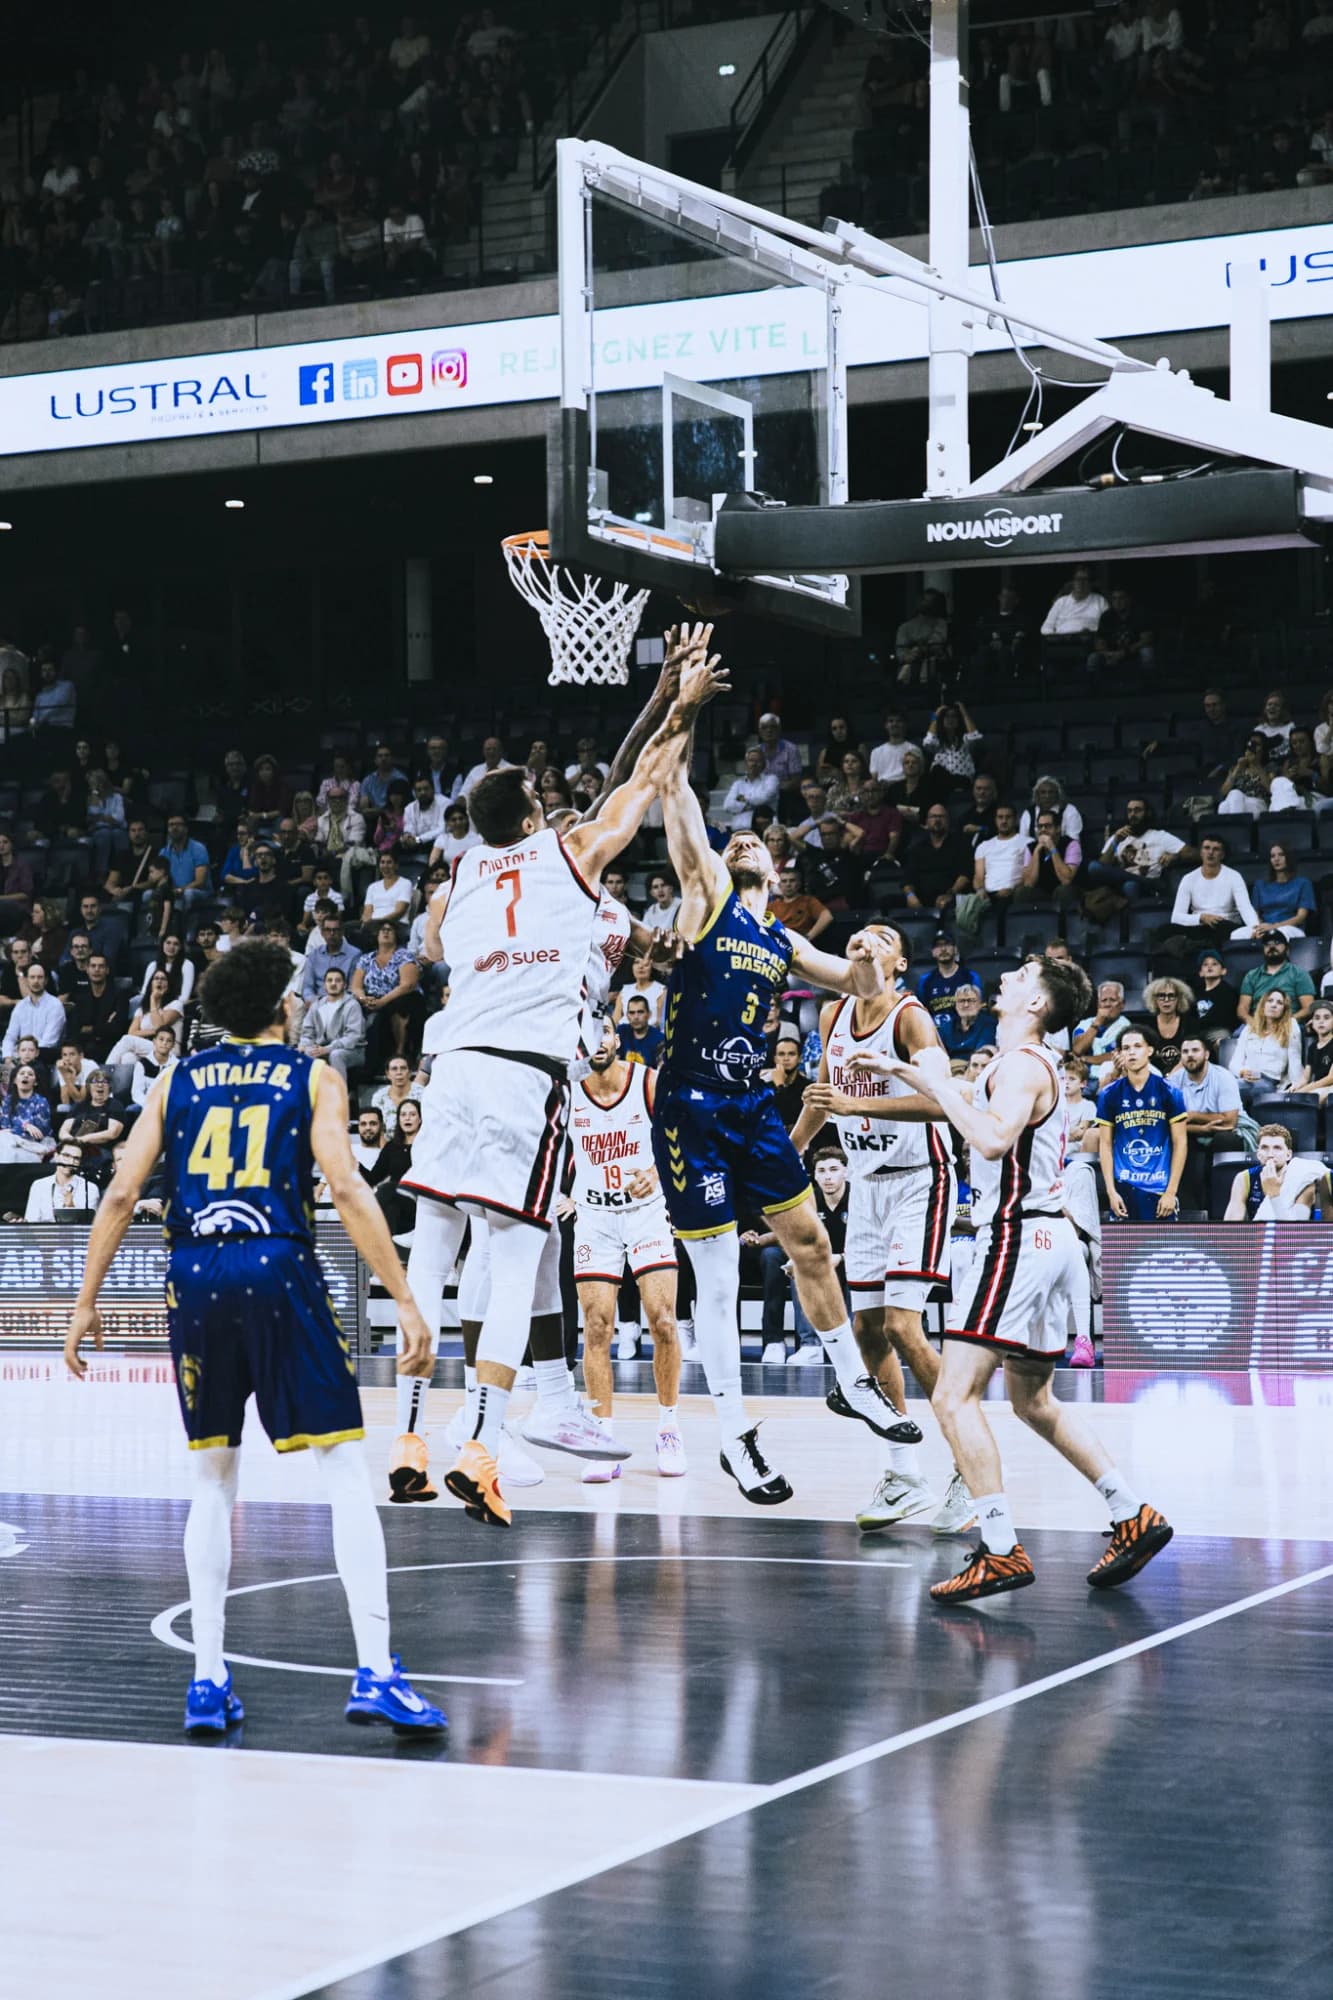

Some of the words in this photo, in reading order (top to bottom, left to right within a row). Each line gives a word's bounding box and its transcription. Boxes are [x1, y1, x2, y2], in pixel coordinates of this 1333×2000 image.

[1225, 250, 1333, 287] US
[499, 331, 694, 377] REJGNEZ
[709, 322, 787, 354] VITE
[802, 330, 830, 357] L
[51, 373, 267, 420] LUSTRAL
[926, 513, 1063, 542] NOUANSPORT
[495, 869, 521, 937] 7
[511, 949, 560, 965] suez
[741, 991, 759, 1025] 3
[189, 1060, 271, 1090] VITALE
[1122, 1118, 1159, 1129] BASKET
[187, 1104, 271, 1190] 41
[582, 1130, 627, 1152] DENAIN
[588, 1141, 641, 1166] VOLTAIRE
[844, 1132, 898, 1152] SKF
[602, 1164, 622, 1190] 19
[705, 1181, 726, 1202] ASI
[1034, 1230, 1053, 1251] 66
[52, 1248, 171, 1288] SEVIC
